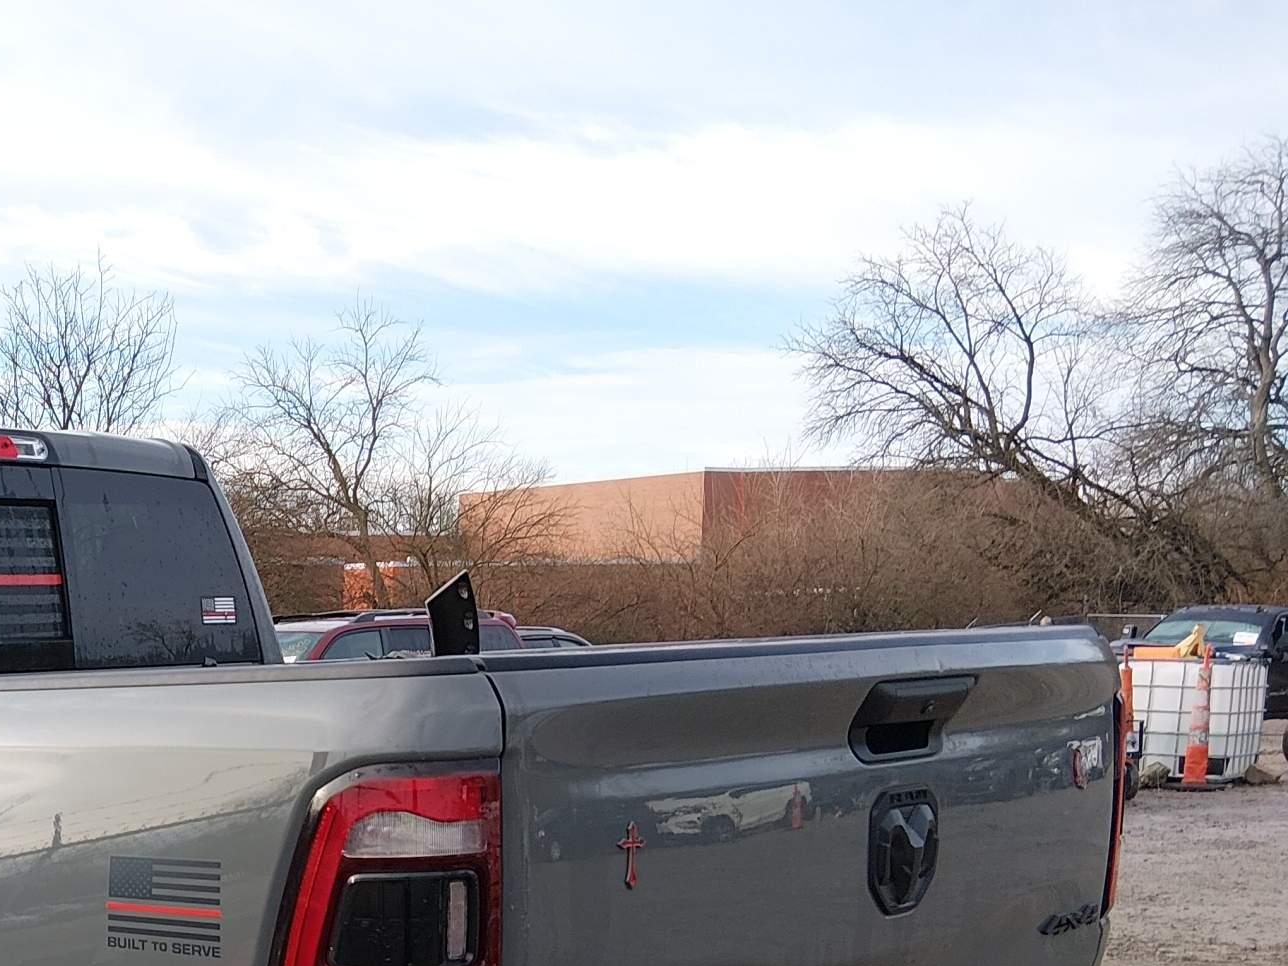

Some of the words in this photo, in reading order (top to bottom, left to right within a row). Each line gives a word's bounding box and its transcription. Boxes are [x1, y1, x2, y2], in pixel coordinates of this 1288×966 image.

[107, 936, 148, 951] BUILT
[151, 941, 168, 952] TO
[172, 943, 221, 958] SERVE
